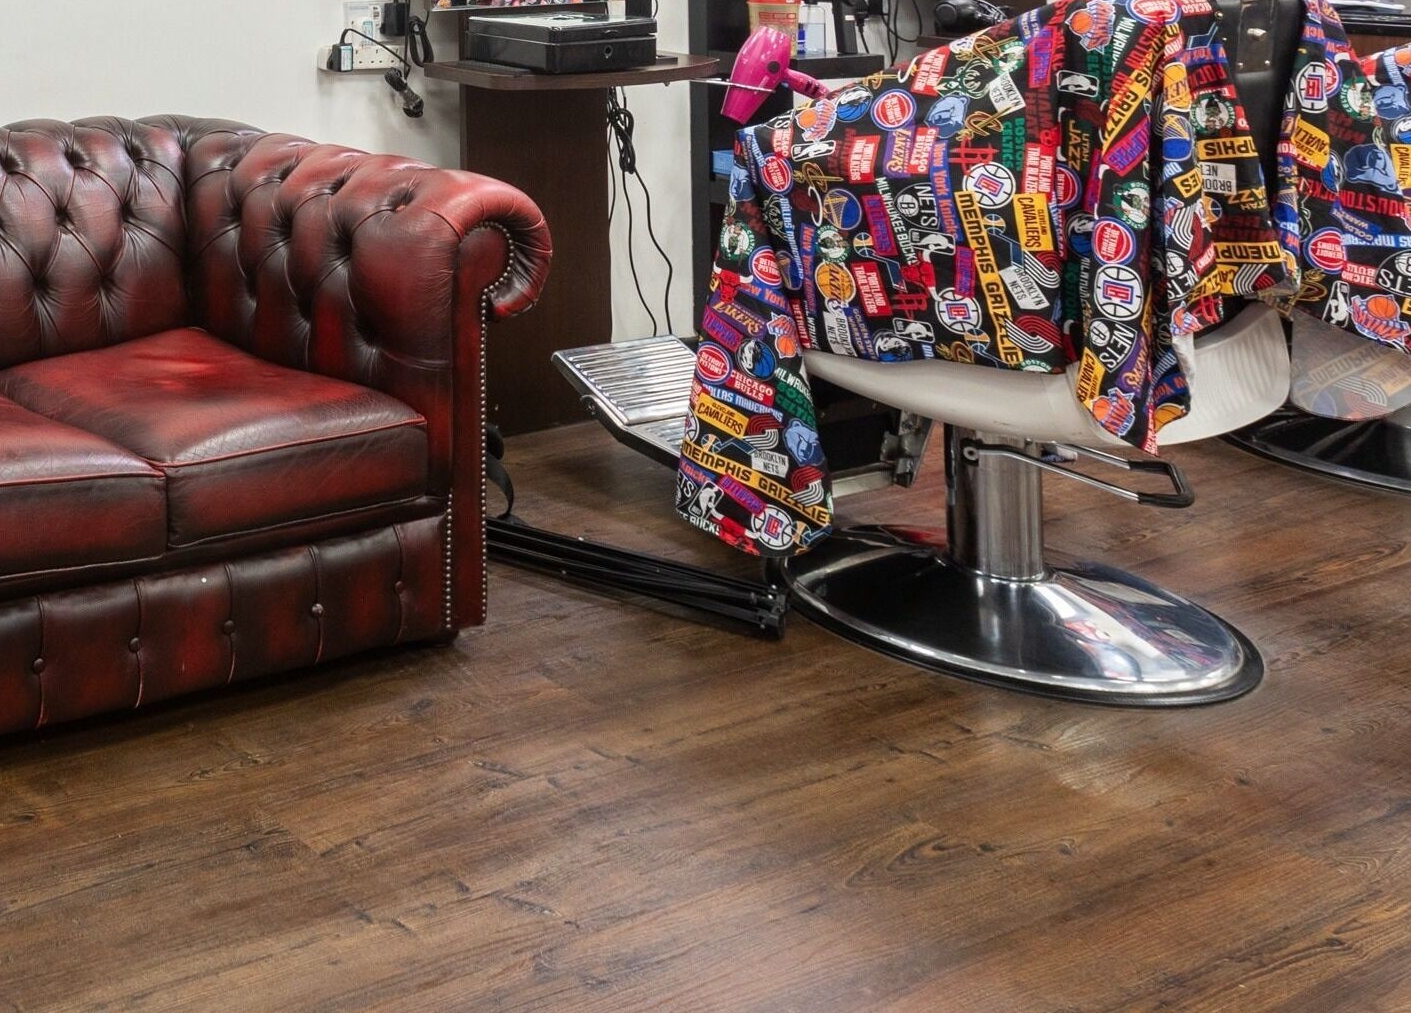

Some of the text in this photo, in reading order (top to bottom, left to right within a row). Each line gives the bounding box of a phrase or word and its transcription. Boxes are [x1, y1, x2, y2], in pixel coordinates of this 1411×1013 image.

[910, 136, 926, 165] BULLS
[918, 129, 936, 172] CHICAGO
[1068, 120, 1080, 171] JAZZ
[914, 185, 938, 226] NETS
[1017, 197, 1040, 248] CAVALIERS
[958, 193, 993, 274] MEMPHIS
[1009, 279, 1027, 301] NETS
[1099, 323, 1135, 369] NETS
[731, 369, 774, 396] CHICAGO
[734, 382, 764, 401] BULLS
[697, 402, 743, 435] CAVALIERS
[682, 443, 752, 481] MEMPHIS
[763, 462, 779, 476] NETS
